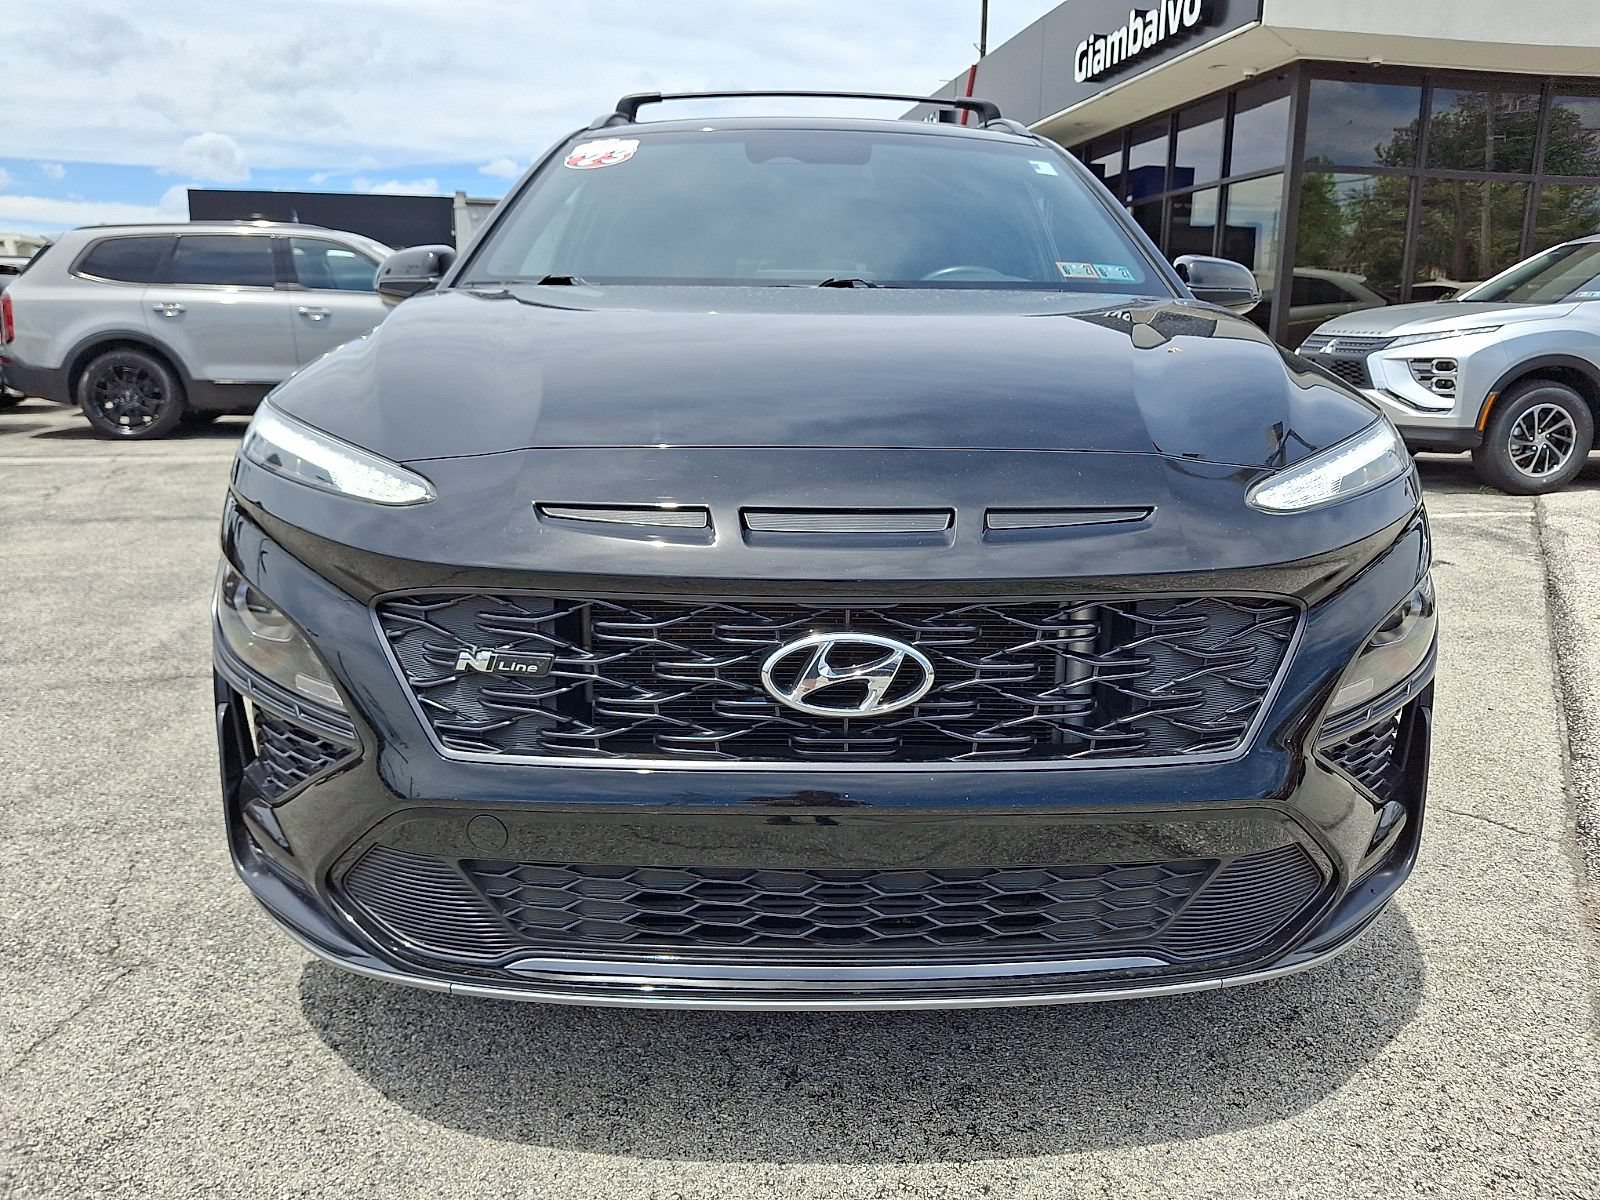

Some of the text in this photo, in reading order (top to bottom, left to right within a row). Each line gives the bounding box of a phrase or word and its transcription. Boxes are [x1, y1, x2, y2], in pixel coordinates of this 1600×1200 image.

[1074, 0, 1201, 83] Giambalvo
[456, 651, 538, 673] N Line
